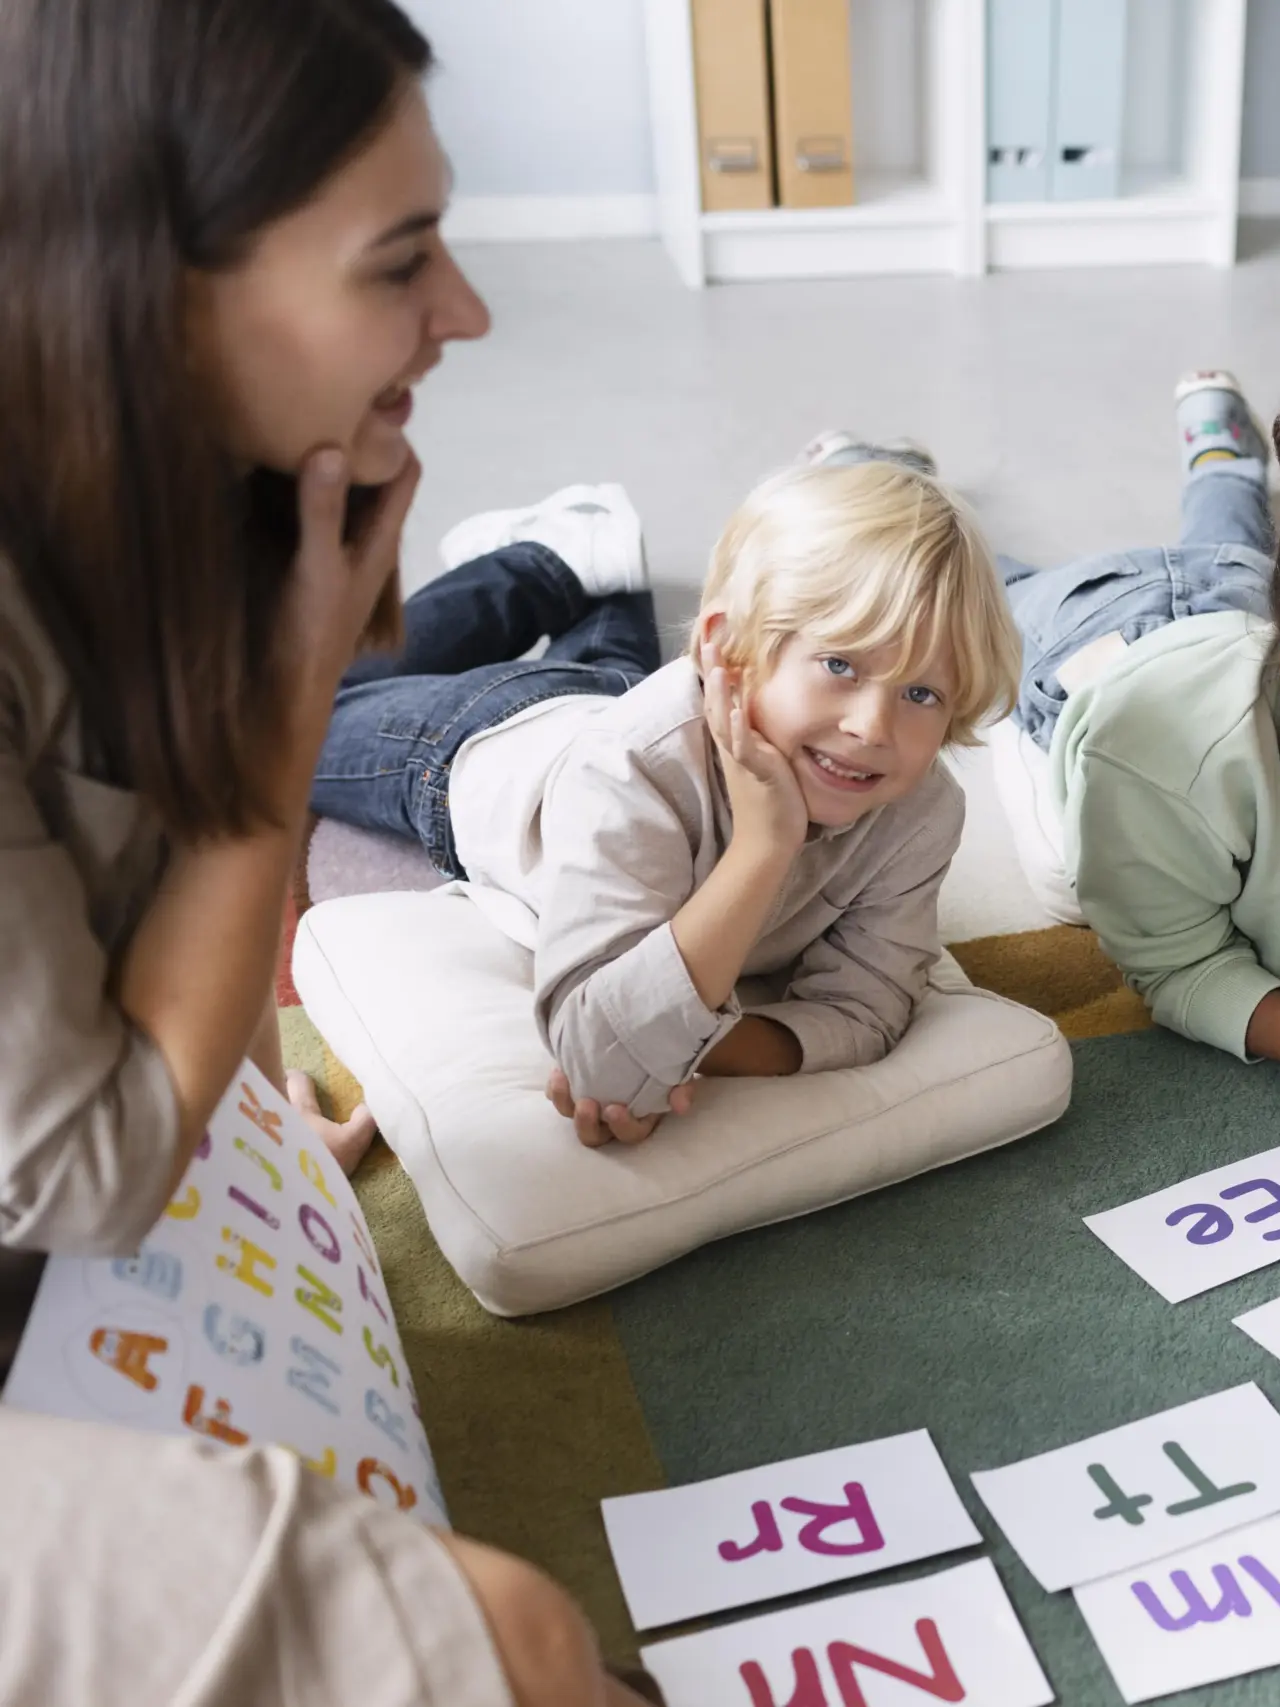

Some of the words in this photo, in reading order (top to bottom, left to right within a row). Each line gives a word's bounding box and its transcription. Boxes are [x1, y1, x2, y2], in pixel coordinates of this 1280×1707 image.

[238, 1082, 283, 1146] K
[233, 1136, 283, 1192] J
[298, 1148, 338, 1209] P
[228, 1185, 280, 1231] I
[298, 1203, 342, 1264] O
[216, 1225, 278, 1298] H
[295, 1264, 344, 1336] N
[89, 1327, 168, 1391] A
[204, 1303, 265, 1366] G
[362, 1325, 400, 1389] S
[286, 1335, 343, 1417] M
[182, 1385, 250, 1447] F
[365, 1388, 409, 1452] R
[1087, 1441, 1257, 1526] Tt
[718, 1482, 885, 1562] Rr
